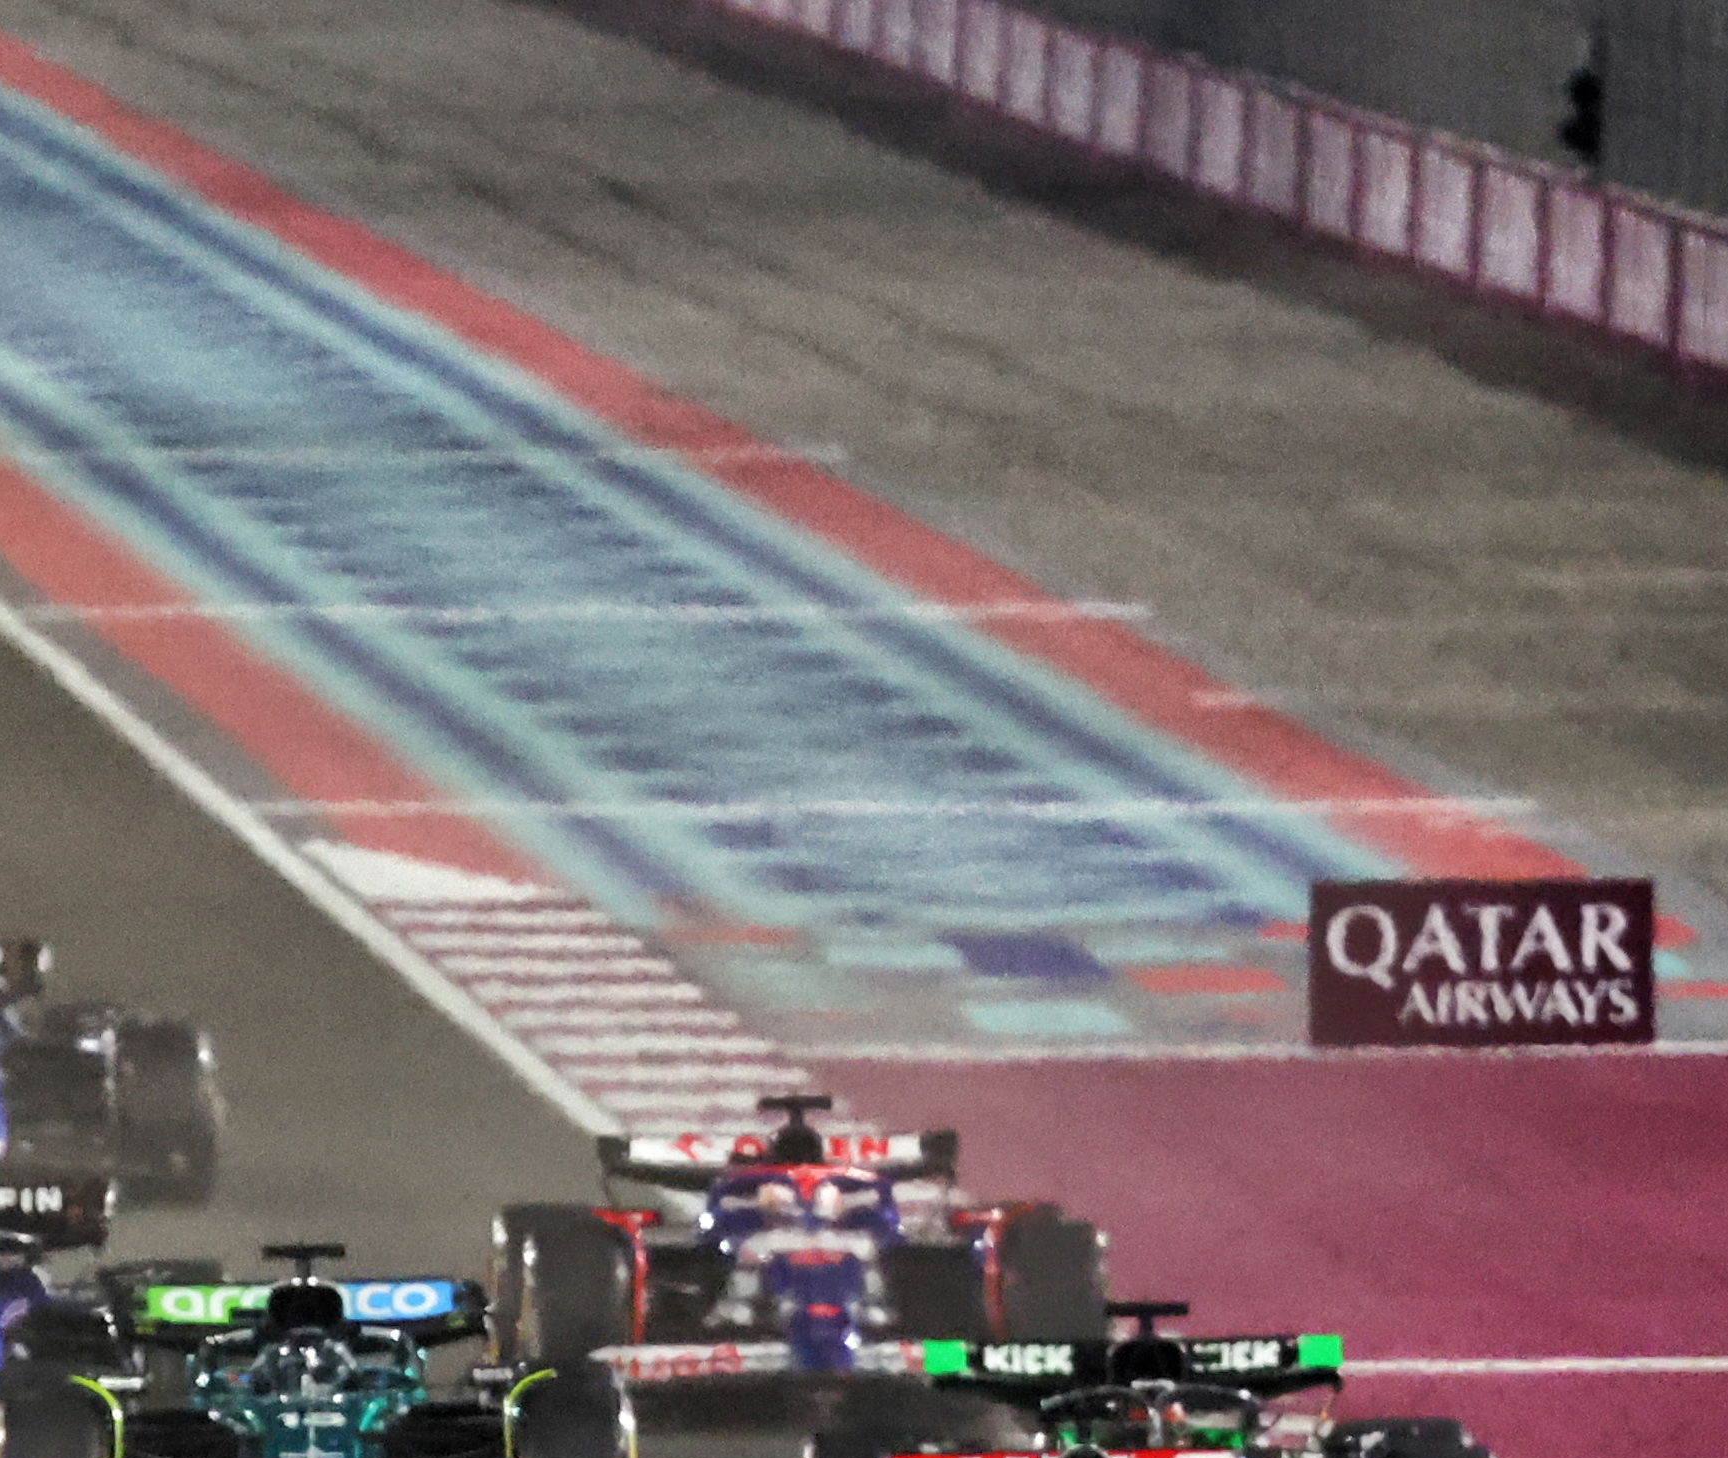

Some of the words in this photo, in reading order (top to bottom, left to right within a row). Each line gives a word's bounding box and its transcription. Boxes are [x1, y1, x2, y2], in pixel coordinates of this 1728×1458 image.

[1326, 904, 1633, 990] QATAR
[1397, 979, 1638, 1026] AIRWAYS
[984, 1345, 1072, 1374] KICK
